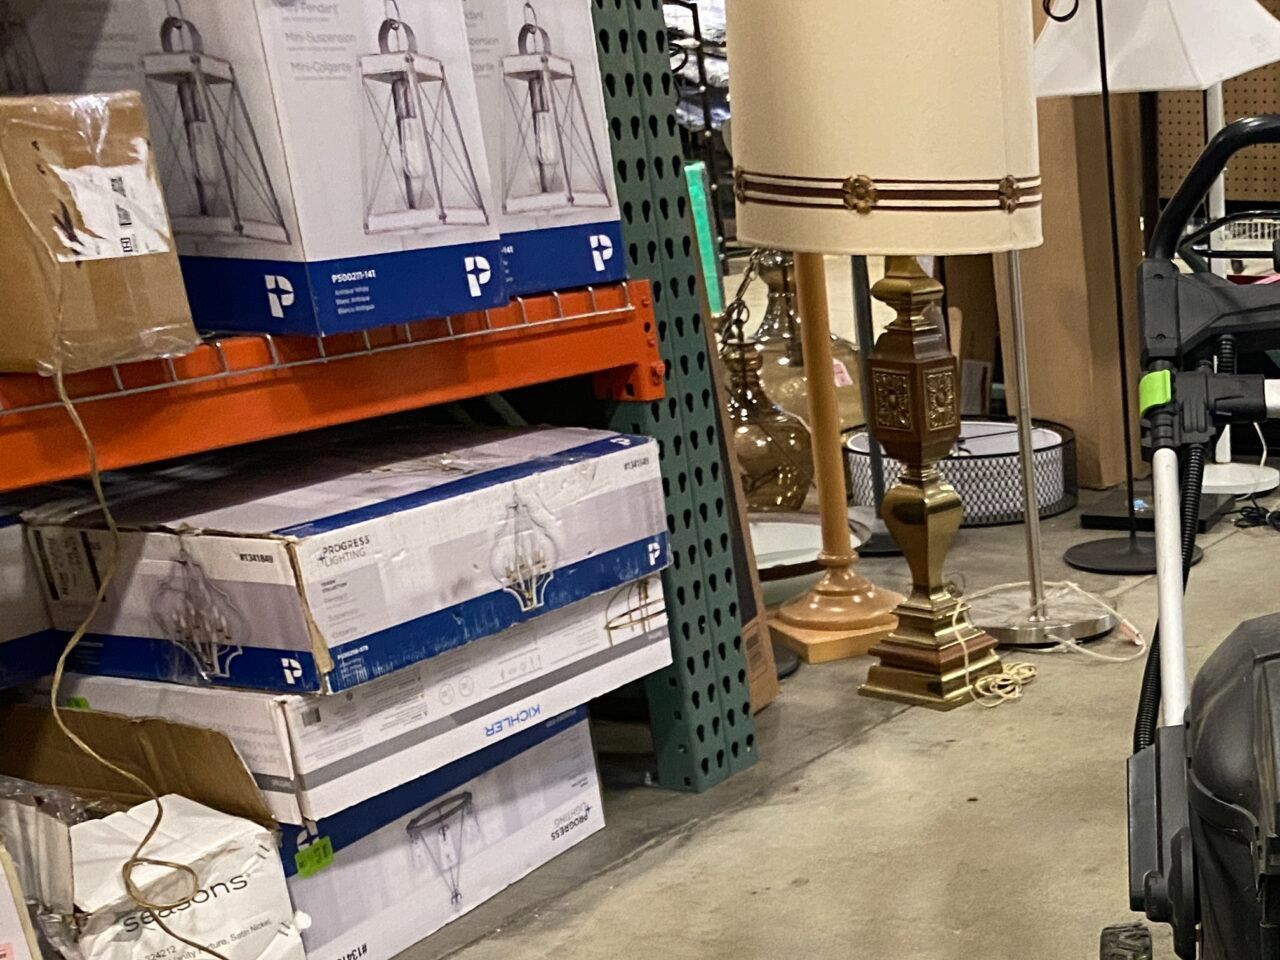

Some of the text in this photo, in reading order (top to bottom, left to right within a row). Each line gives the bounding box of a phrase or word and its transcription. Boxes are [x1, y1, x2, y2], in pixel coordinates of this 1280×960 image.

[322, 535, 370, 555] PROGRESS
[325, 547, 367, 568] LIGHTING
[484, 704, 541, 738] KICHLER
[550, 813, 589, 842] PROGRESS
